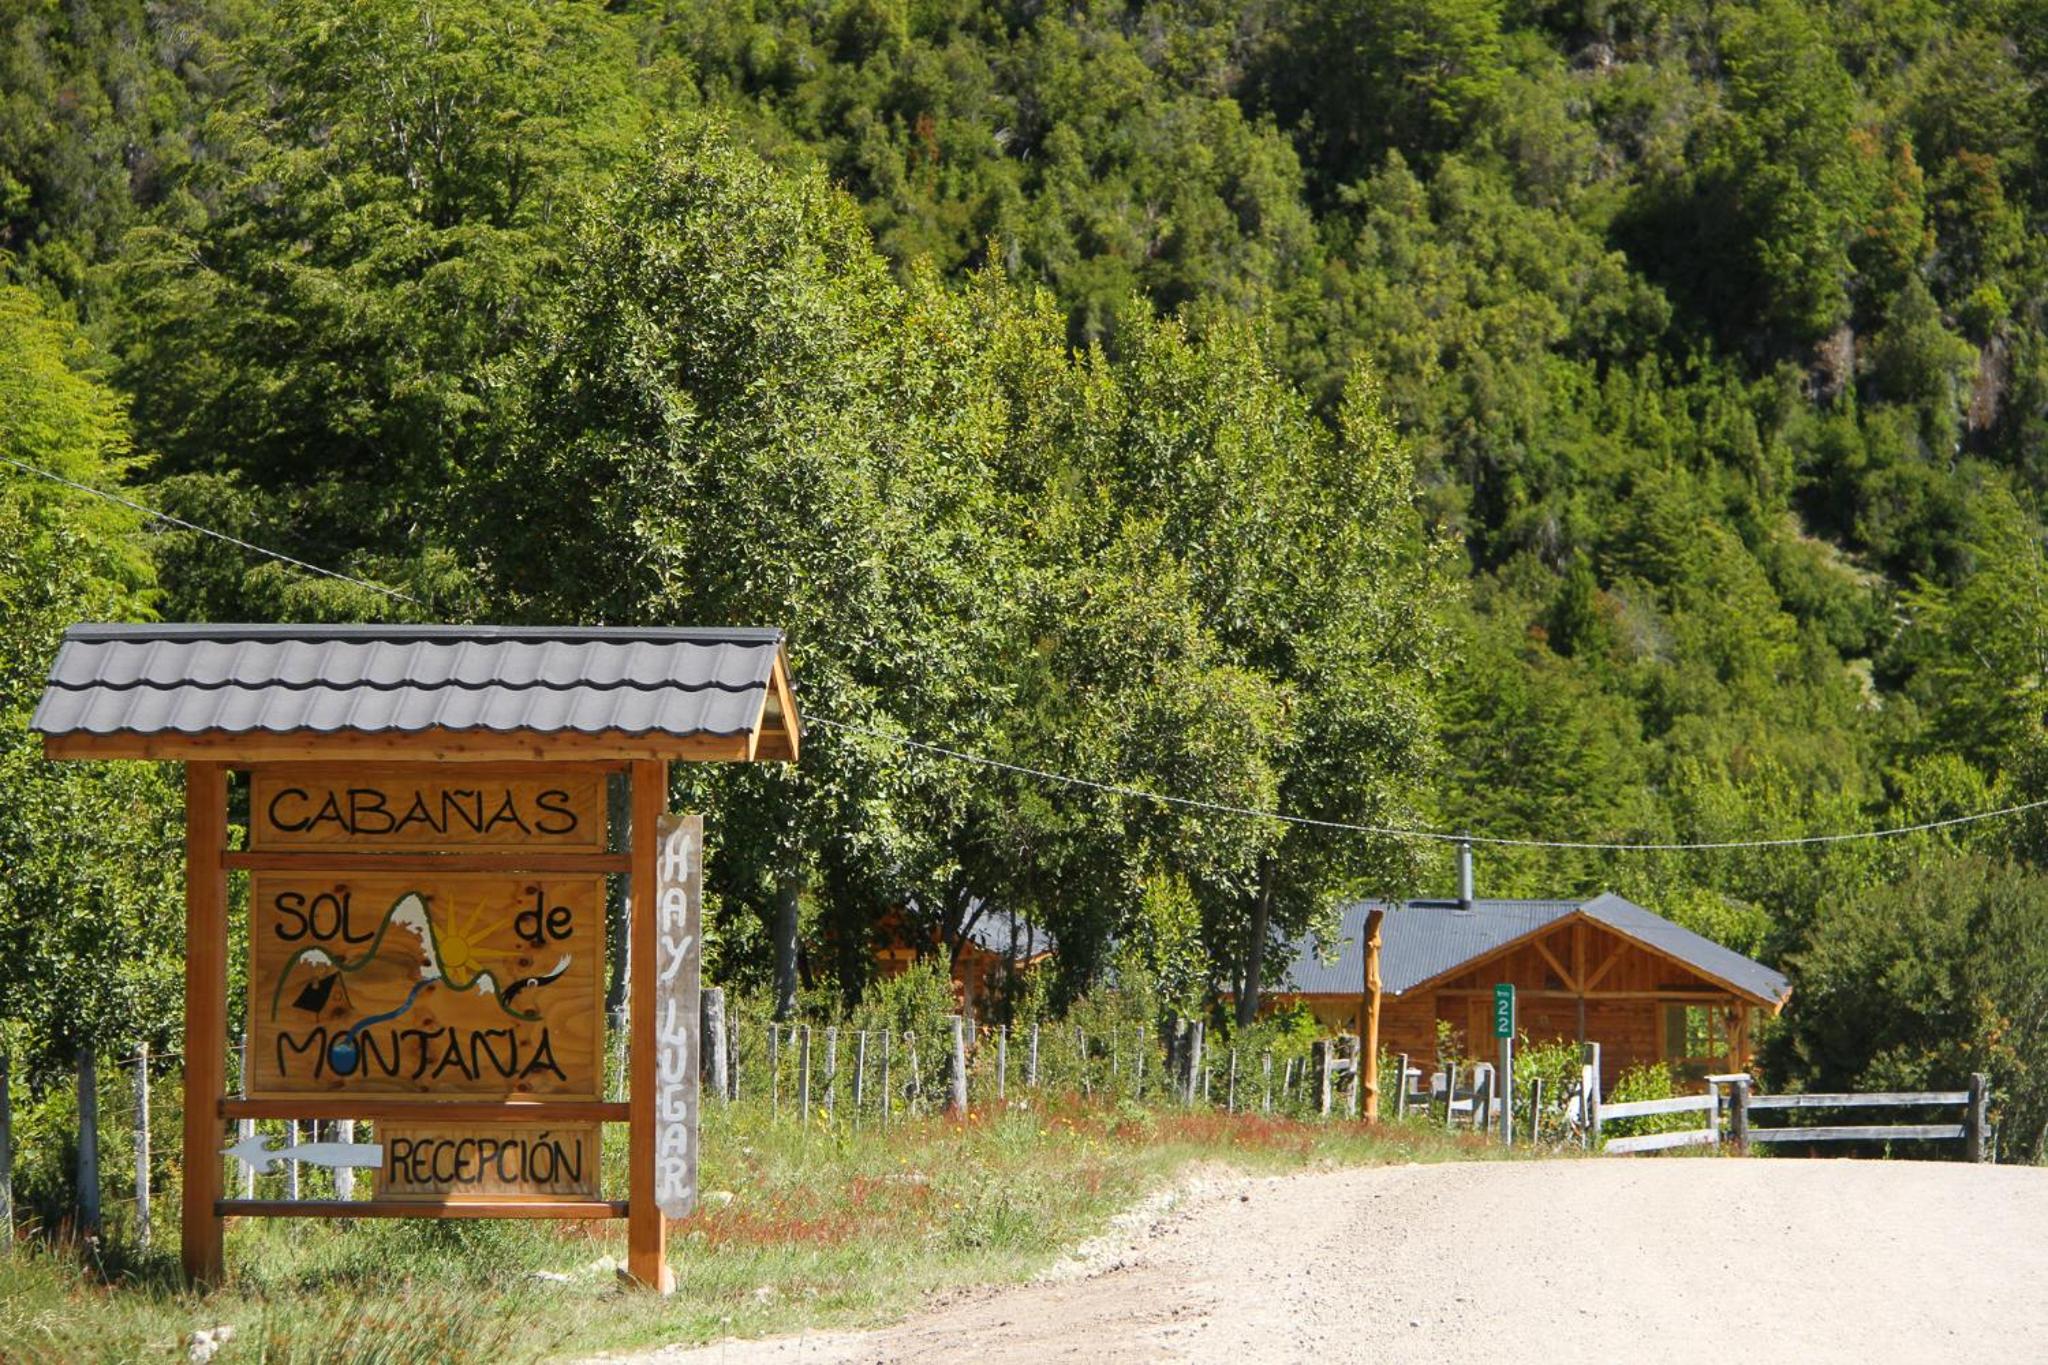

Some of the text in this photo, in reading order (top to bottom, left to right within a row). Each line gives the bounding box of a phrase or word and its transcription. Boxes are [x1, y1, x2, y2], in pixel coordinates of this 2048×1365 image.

[268, 788, 578, 835] CABAÑAS
[274, 890, 573, 945] SOL de
[661, 831, 693, 1199] HAY LUGAR
[277, 1026, 567, 1082] MONTAÑA
[389, 1131, 582, 1184] RECEPCIÓN
